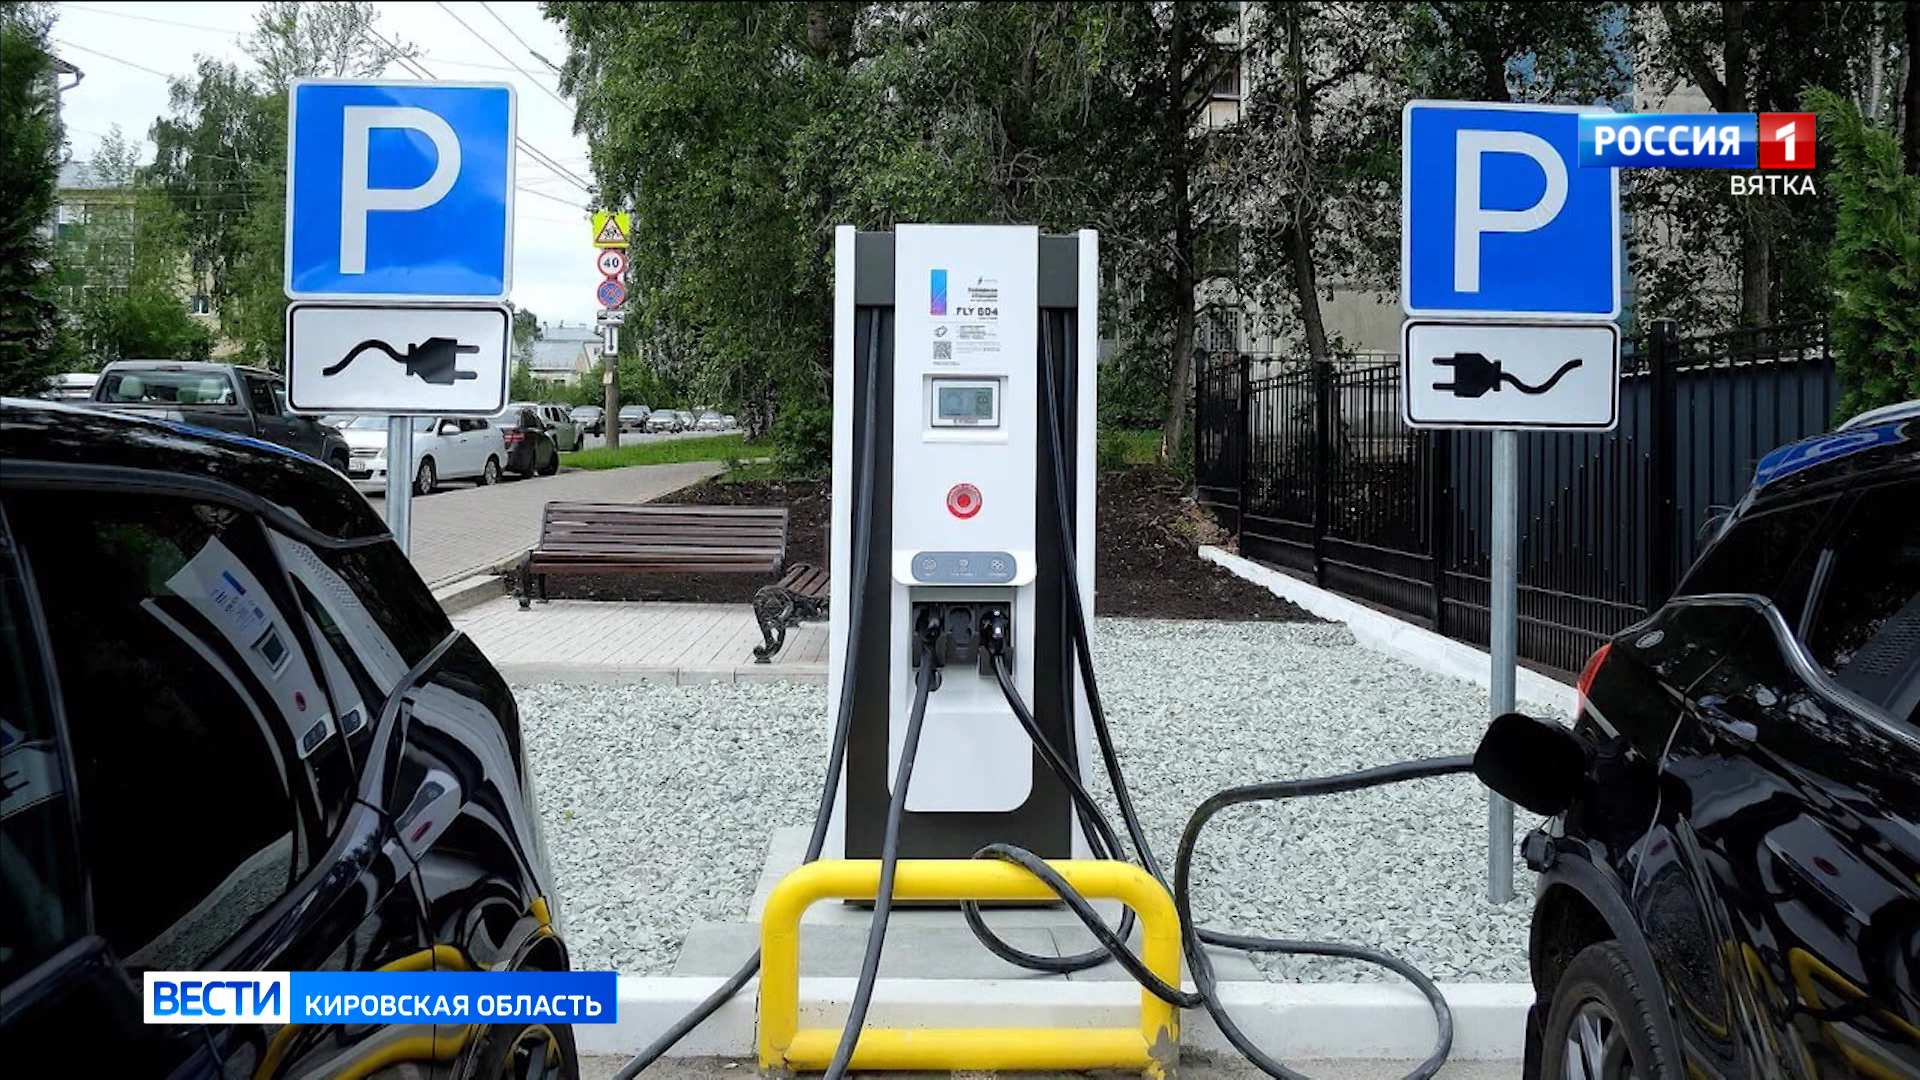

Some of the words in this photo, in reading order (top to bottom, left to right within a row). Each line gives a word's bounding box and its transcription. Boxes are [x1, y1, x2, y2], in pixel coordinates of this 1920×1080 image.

[340, 106, 461, 274] P
[1454, 129, 1568, 292] P
[603, 257, 619, 268] 40
[956, 306, 975, 316] FLY
